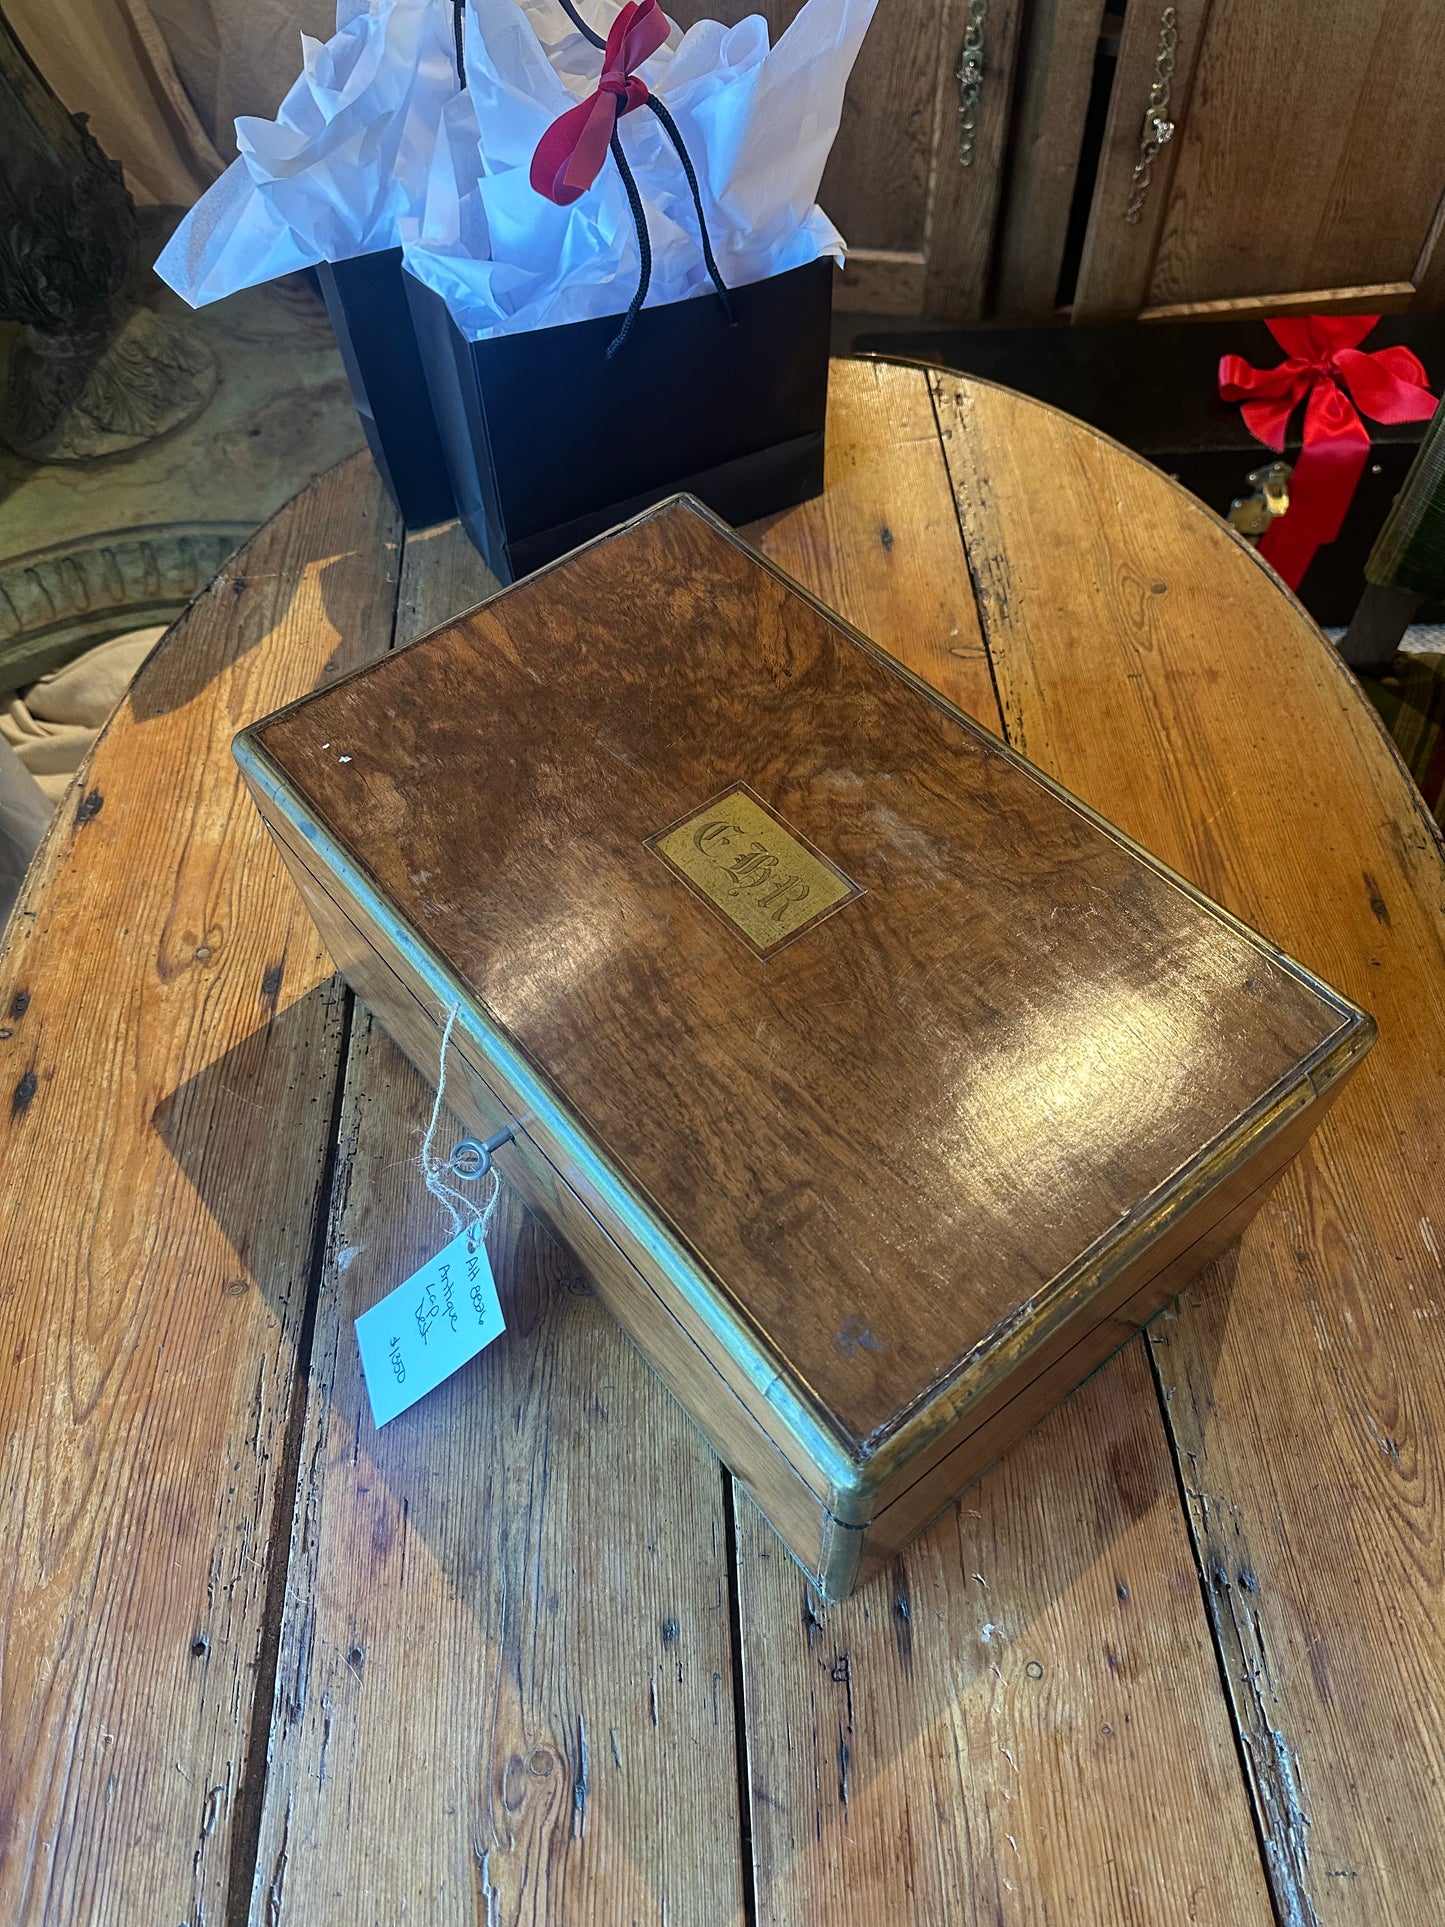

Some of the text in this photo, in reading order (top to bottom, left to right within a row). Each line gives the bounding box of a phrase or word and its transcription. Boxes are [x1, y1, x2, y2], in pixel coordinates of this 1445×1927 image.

[465, 1256, 481, 1282] AH
[425, 1283, 440, 1318] Lap
[438, 1264, 458, 1333] Antique
[389, 1336, 406, 1384] $1350
